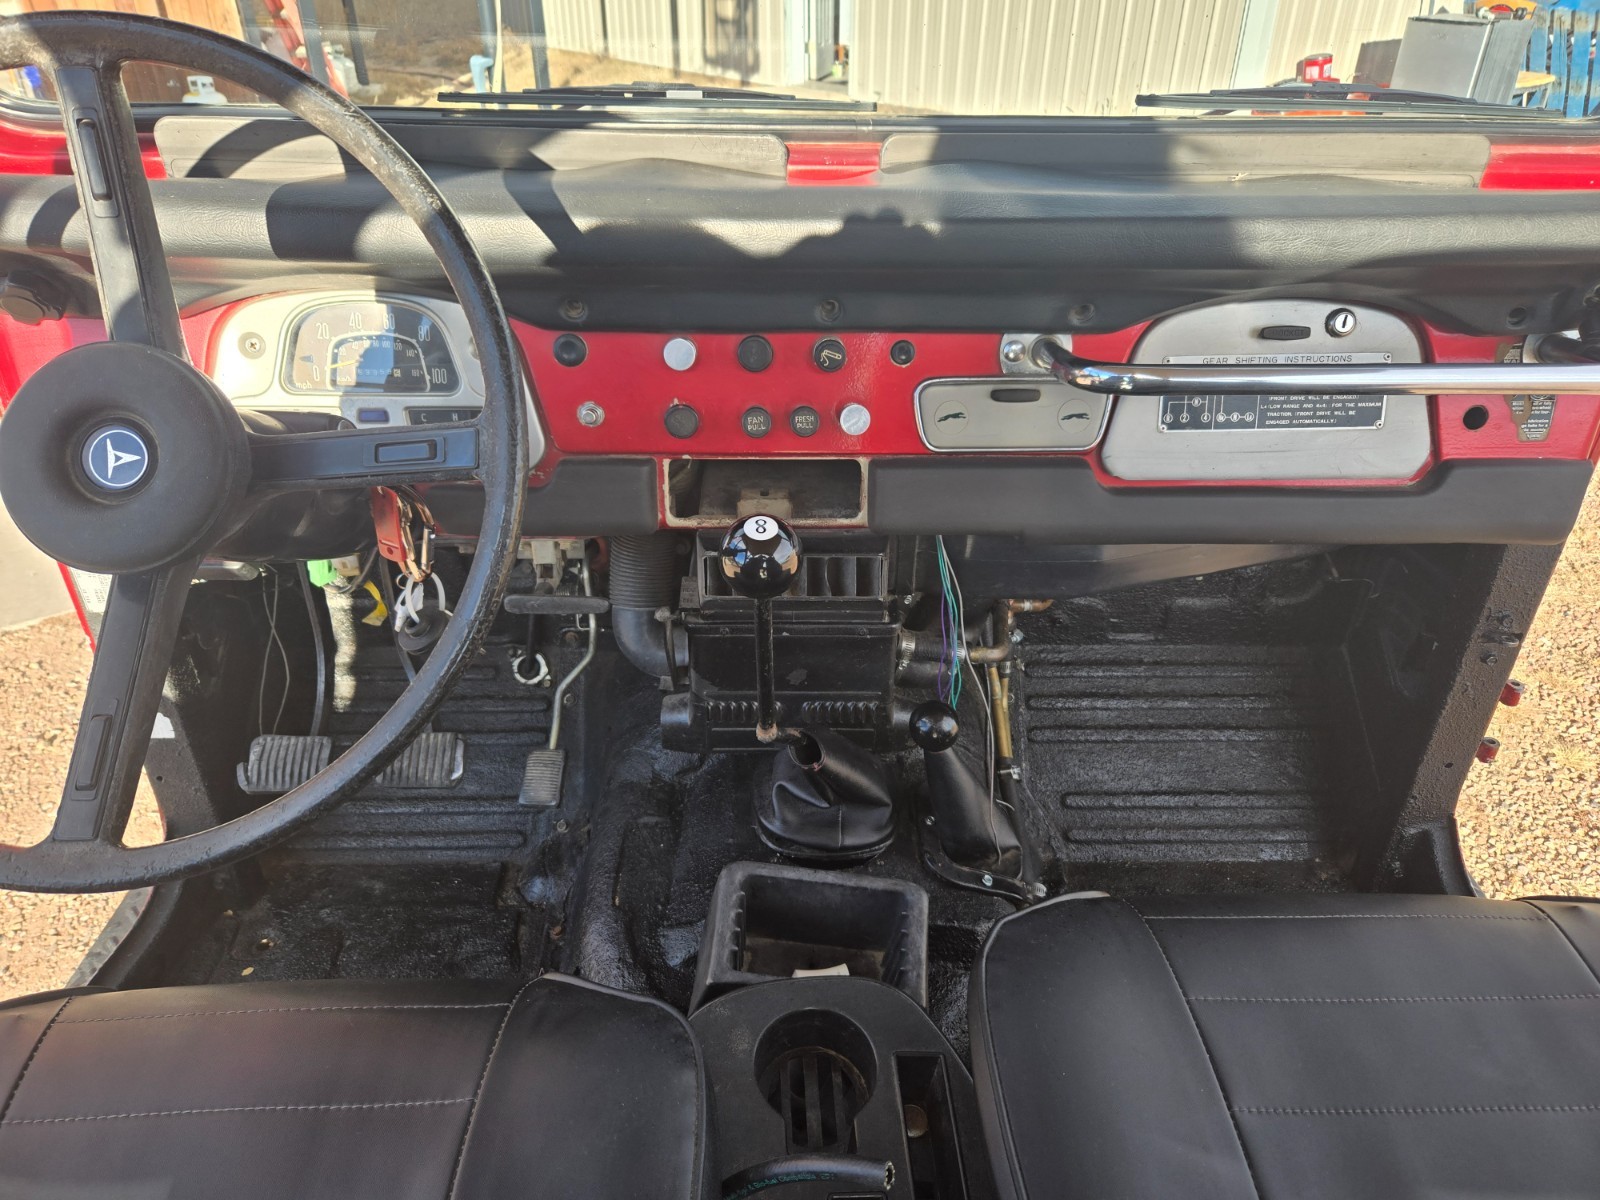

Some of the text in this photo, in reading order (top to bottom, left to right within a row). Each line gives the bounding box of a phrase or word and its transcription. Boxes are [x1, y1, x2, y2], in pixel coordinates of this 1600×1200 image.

[349, 312, 362, 330] 40
[383, 313, 396, 330] 60
[316, 322, 330, 340] 20
[418, 325, 431, 342] 80
[393, 342, 402, 350] 120
[406, 349, 415, 357] 140
[1235, 356, 1278, 364] SHIFTING
[1284, 354, 1353, 363] INSTRUCTIONS
[312, 365, 320, 381] 0
[431, 368, 448, 385] 100
[295, 379, 312, 389] mph
[420, 412, 427, 422] C
[452, 412, 458, 422] H
[748, 416, 764, 424] FAN
[755, 518, 767, 534] 8
